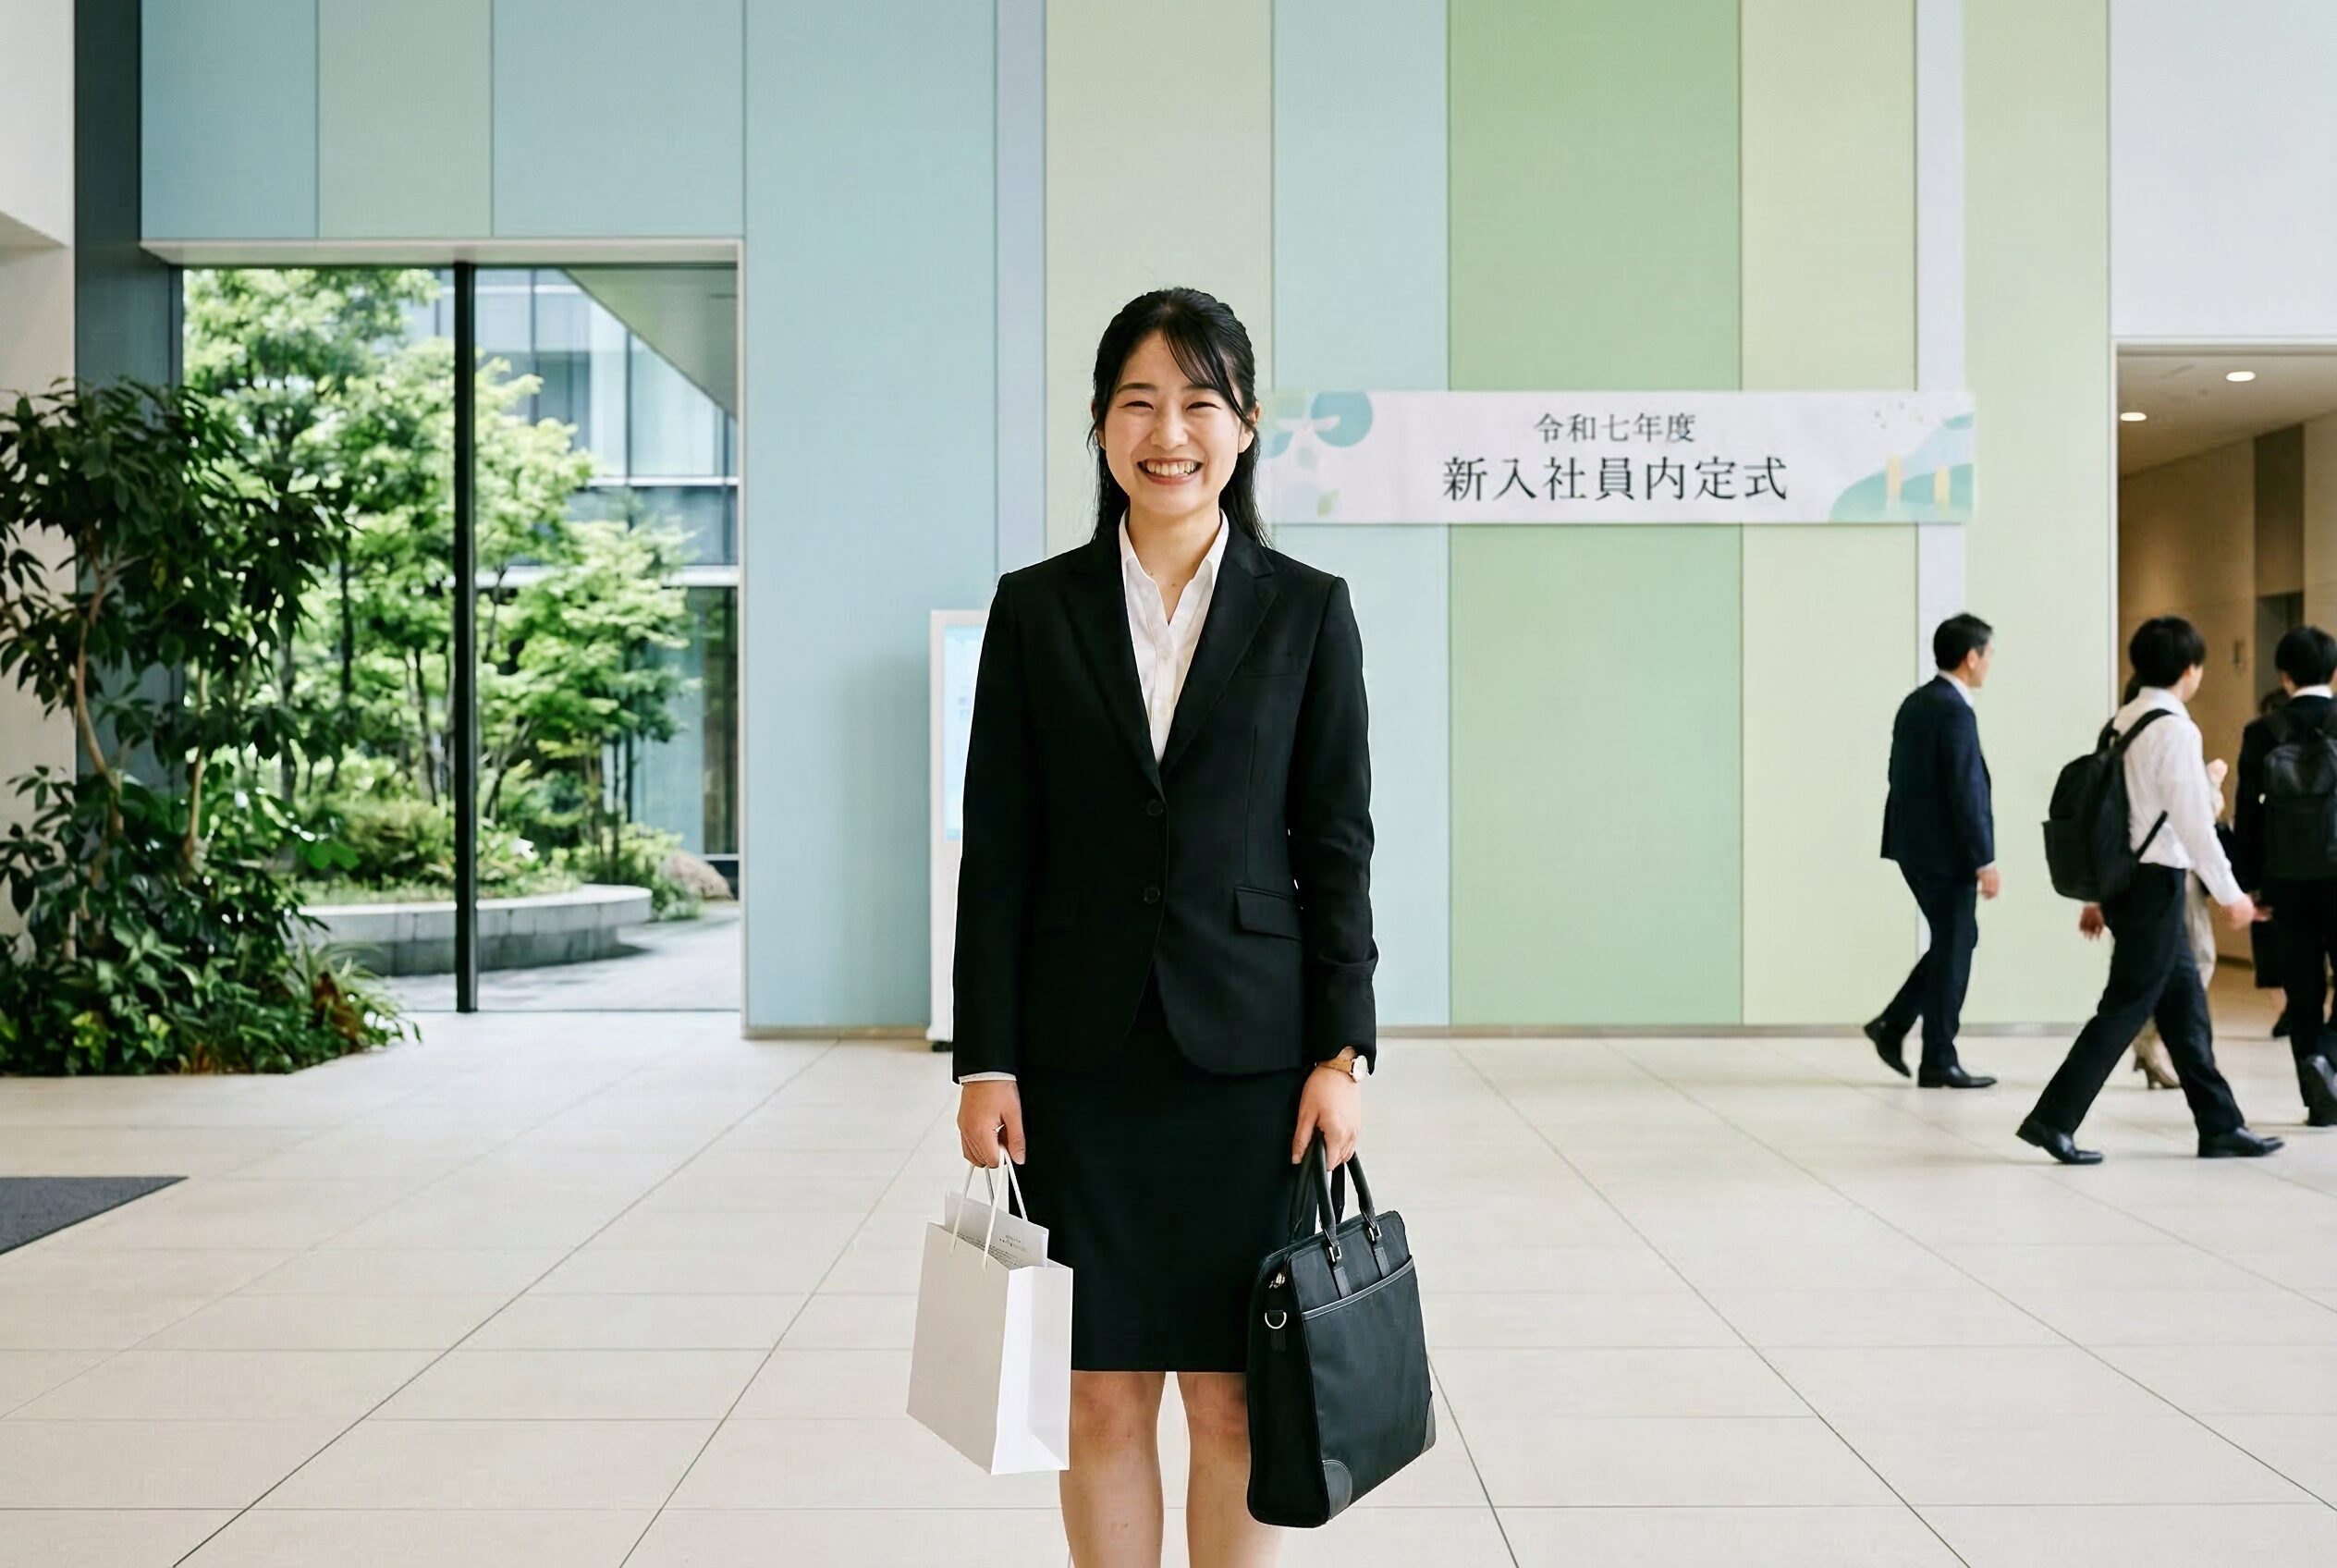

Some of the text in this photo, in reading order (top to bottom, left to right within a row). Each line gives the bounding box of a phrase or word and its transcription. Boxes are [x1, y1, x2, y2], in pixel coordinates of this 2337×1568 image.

[1535, 412, 1695, 443] 令和七年度
[1443, 456, 1787, 501] 新入社員内定式
